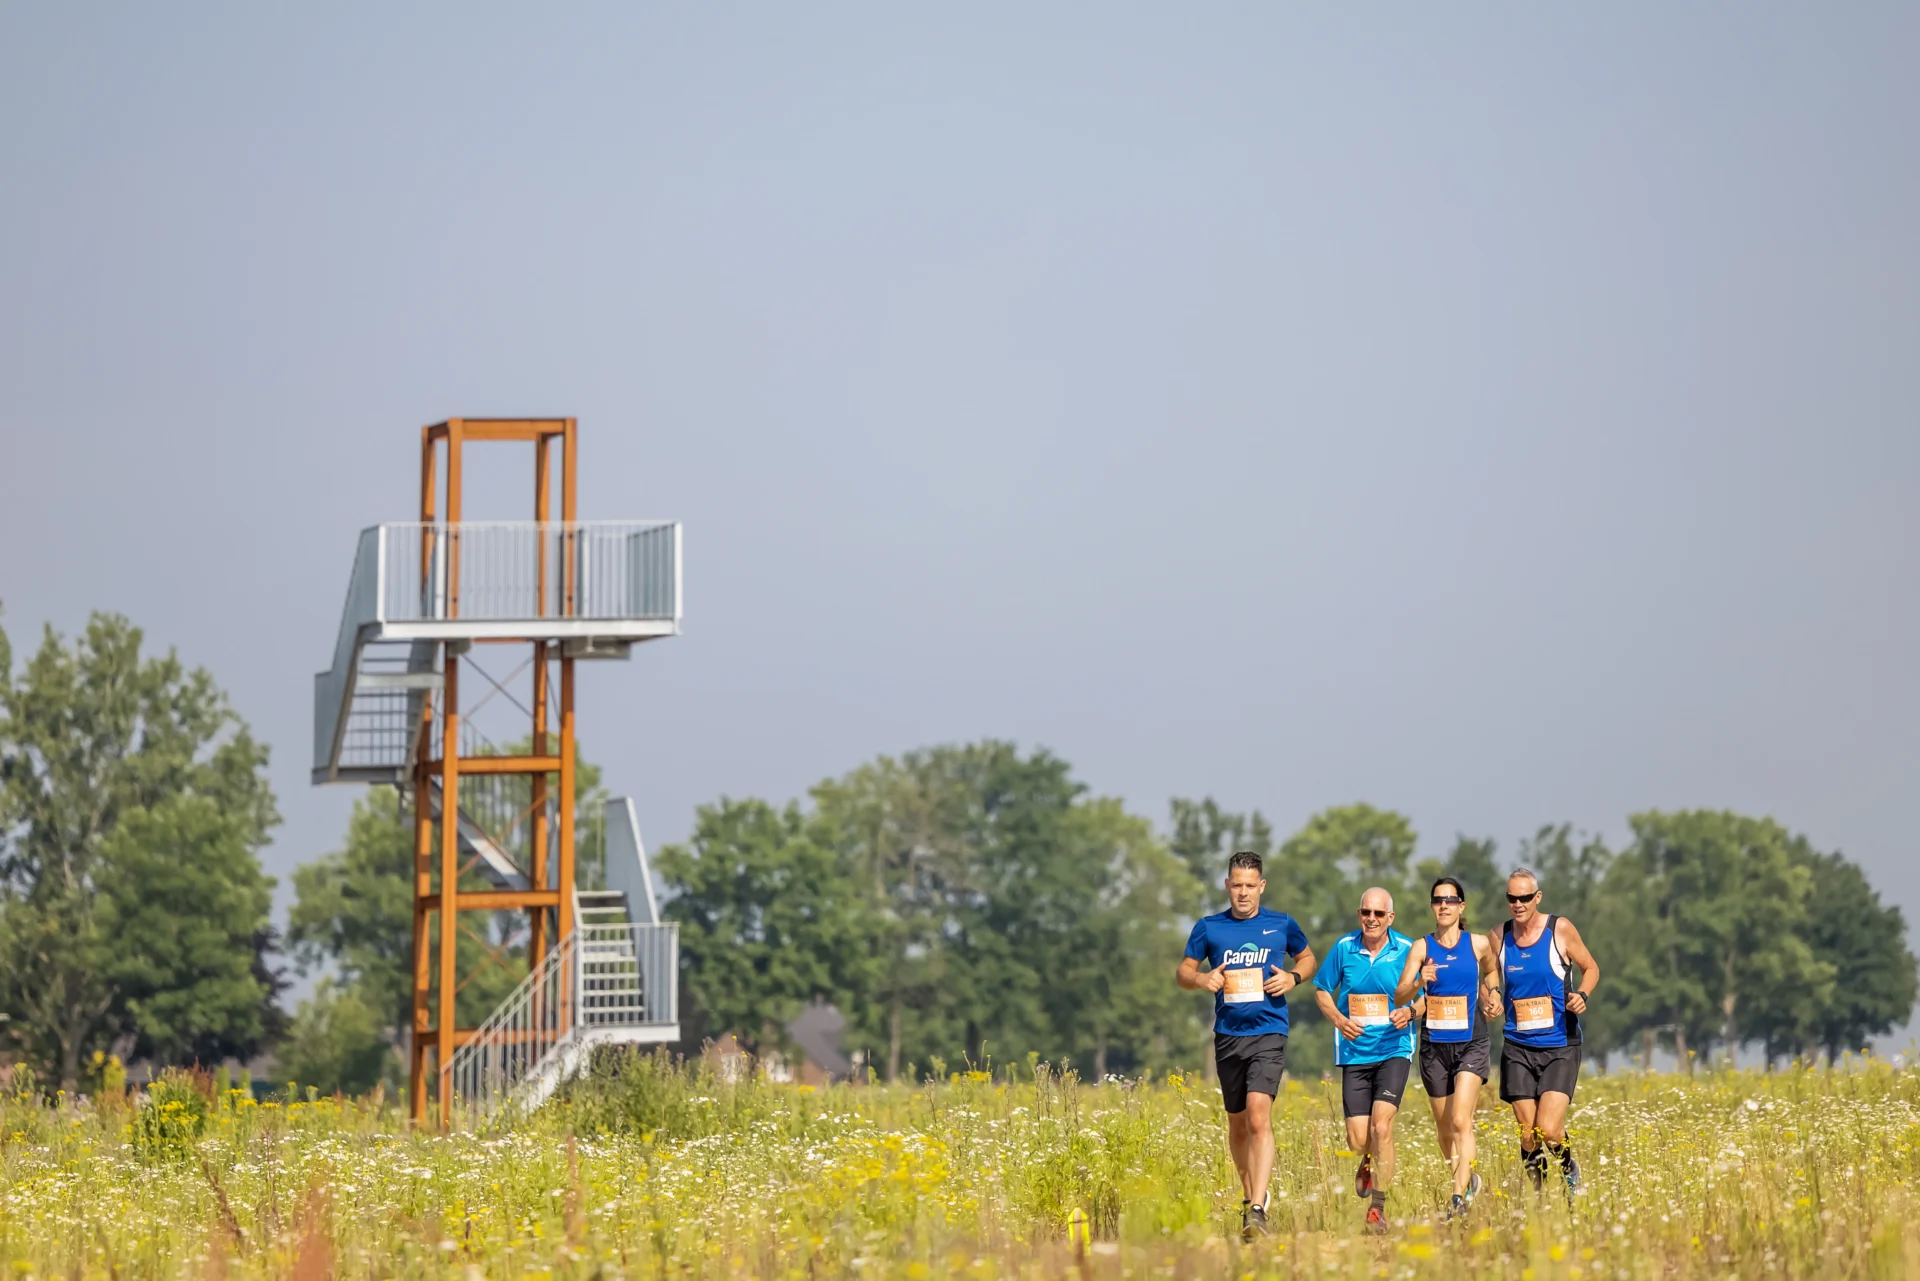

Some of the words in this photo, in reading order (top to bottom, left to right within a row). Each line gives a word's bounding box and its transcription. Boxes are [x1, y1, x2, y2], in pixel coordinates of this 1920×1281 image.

[1223, 948, 1268, 967] Cargill
[1238, 979, 1254, 988] 150
[1365, 1003, 1379, 1011] 152
[1443, 1006, 1457, 1015] 151
[1529, 1006, 1544, 1015] 160
